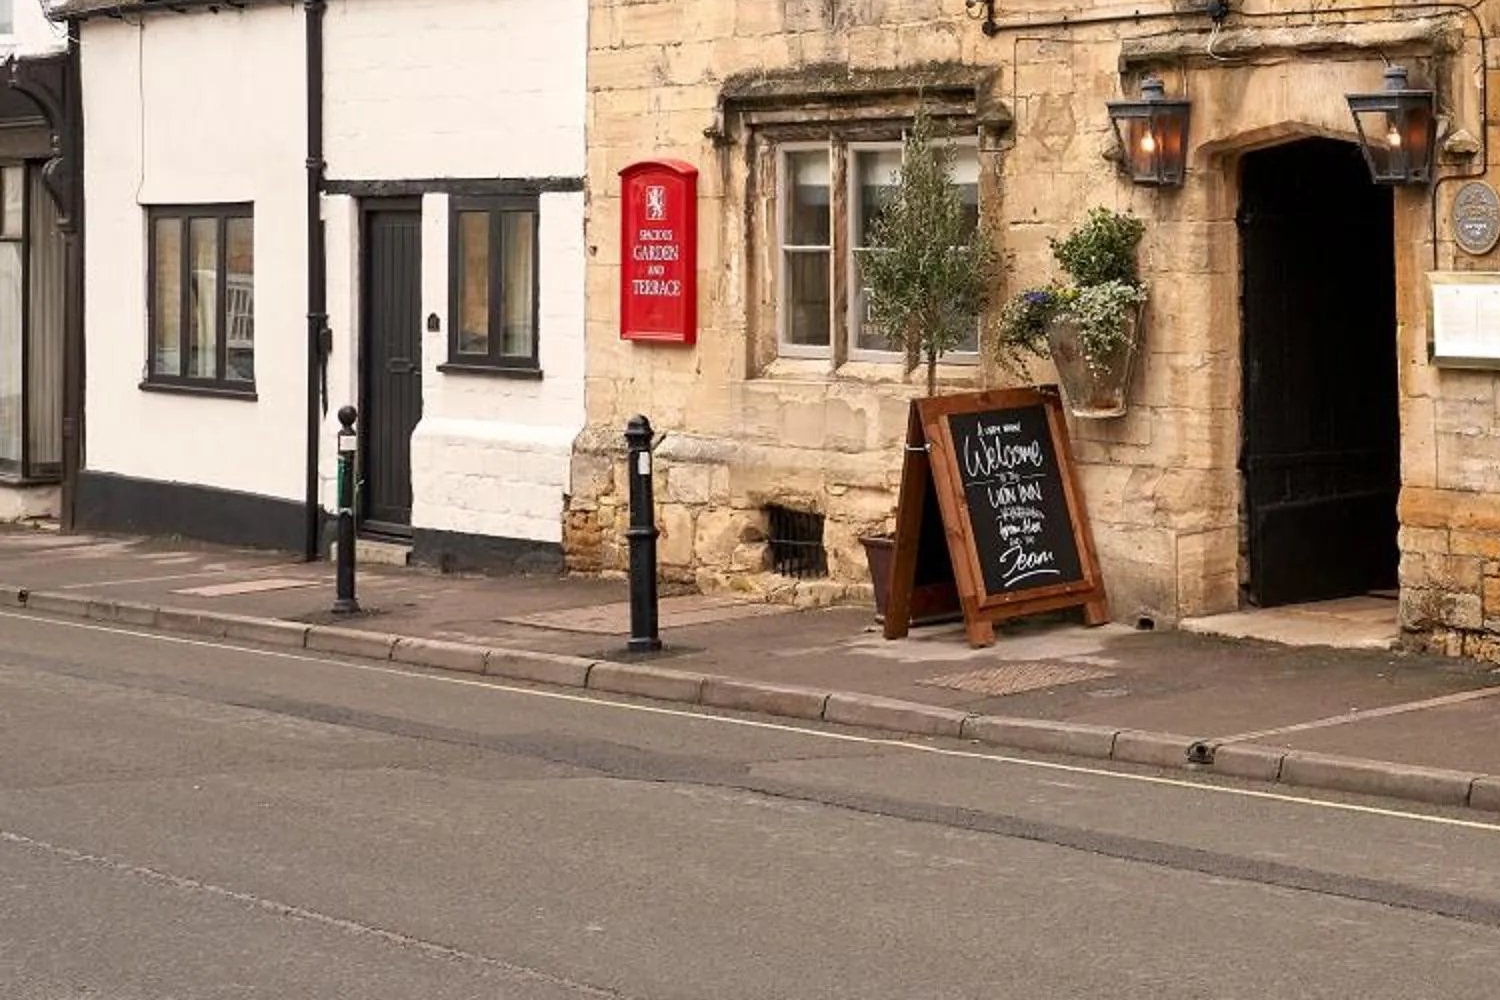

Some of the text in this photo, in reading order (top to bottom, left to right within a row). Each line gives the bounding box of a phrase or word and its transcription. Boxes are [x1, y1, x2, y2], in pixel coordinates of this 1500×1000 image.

[633, 244, 679, 261] GARDEN
[648, 265, 665, 276] AND
[632, 279, 682, 296] TERRACE
[964, 436, 1043, 476] Welcome
